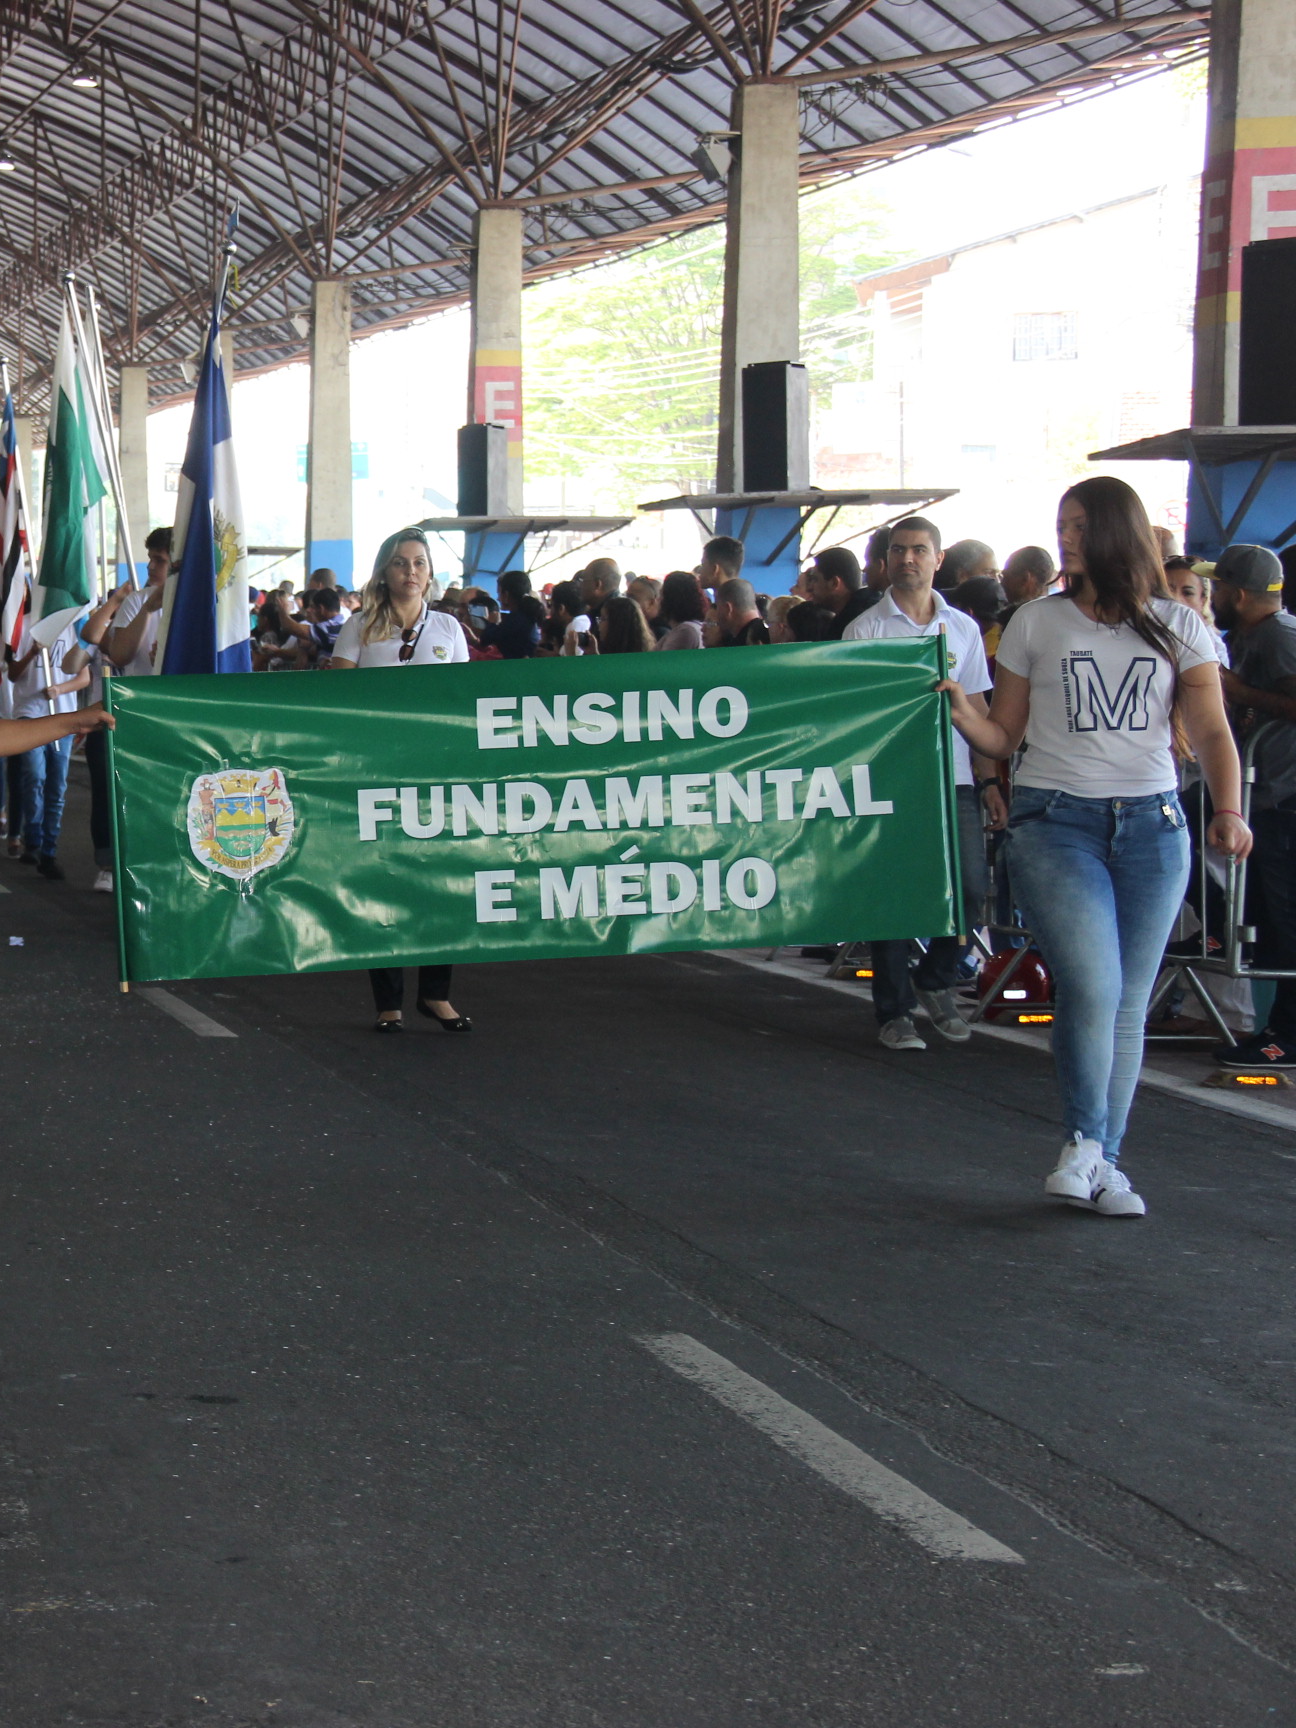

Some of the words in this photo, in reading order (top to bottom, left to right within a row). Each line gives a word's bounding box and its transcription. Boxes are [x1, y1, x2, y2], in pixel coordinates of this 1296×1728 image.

[485, 381, 515, 428] E
[475, 685, 749, 750] ENSINO
[1070, 657, 1157, 732] M
[357, 764, 894, 841] FUNDAMENTAL
[474, 869, 517, 923] E
[539, 844, 777, 920] MÉDIO
[1260, 1044, 1285, 1061] N
